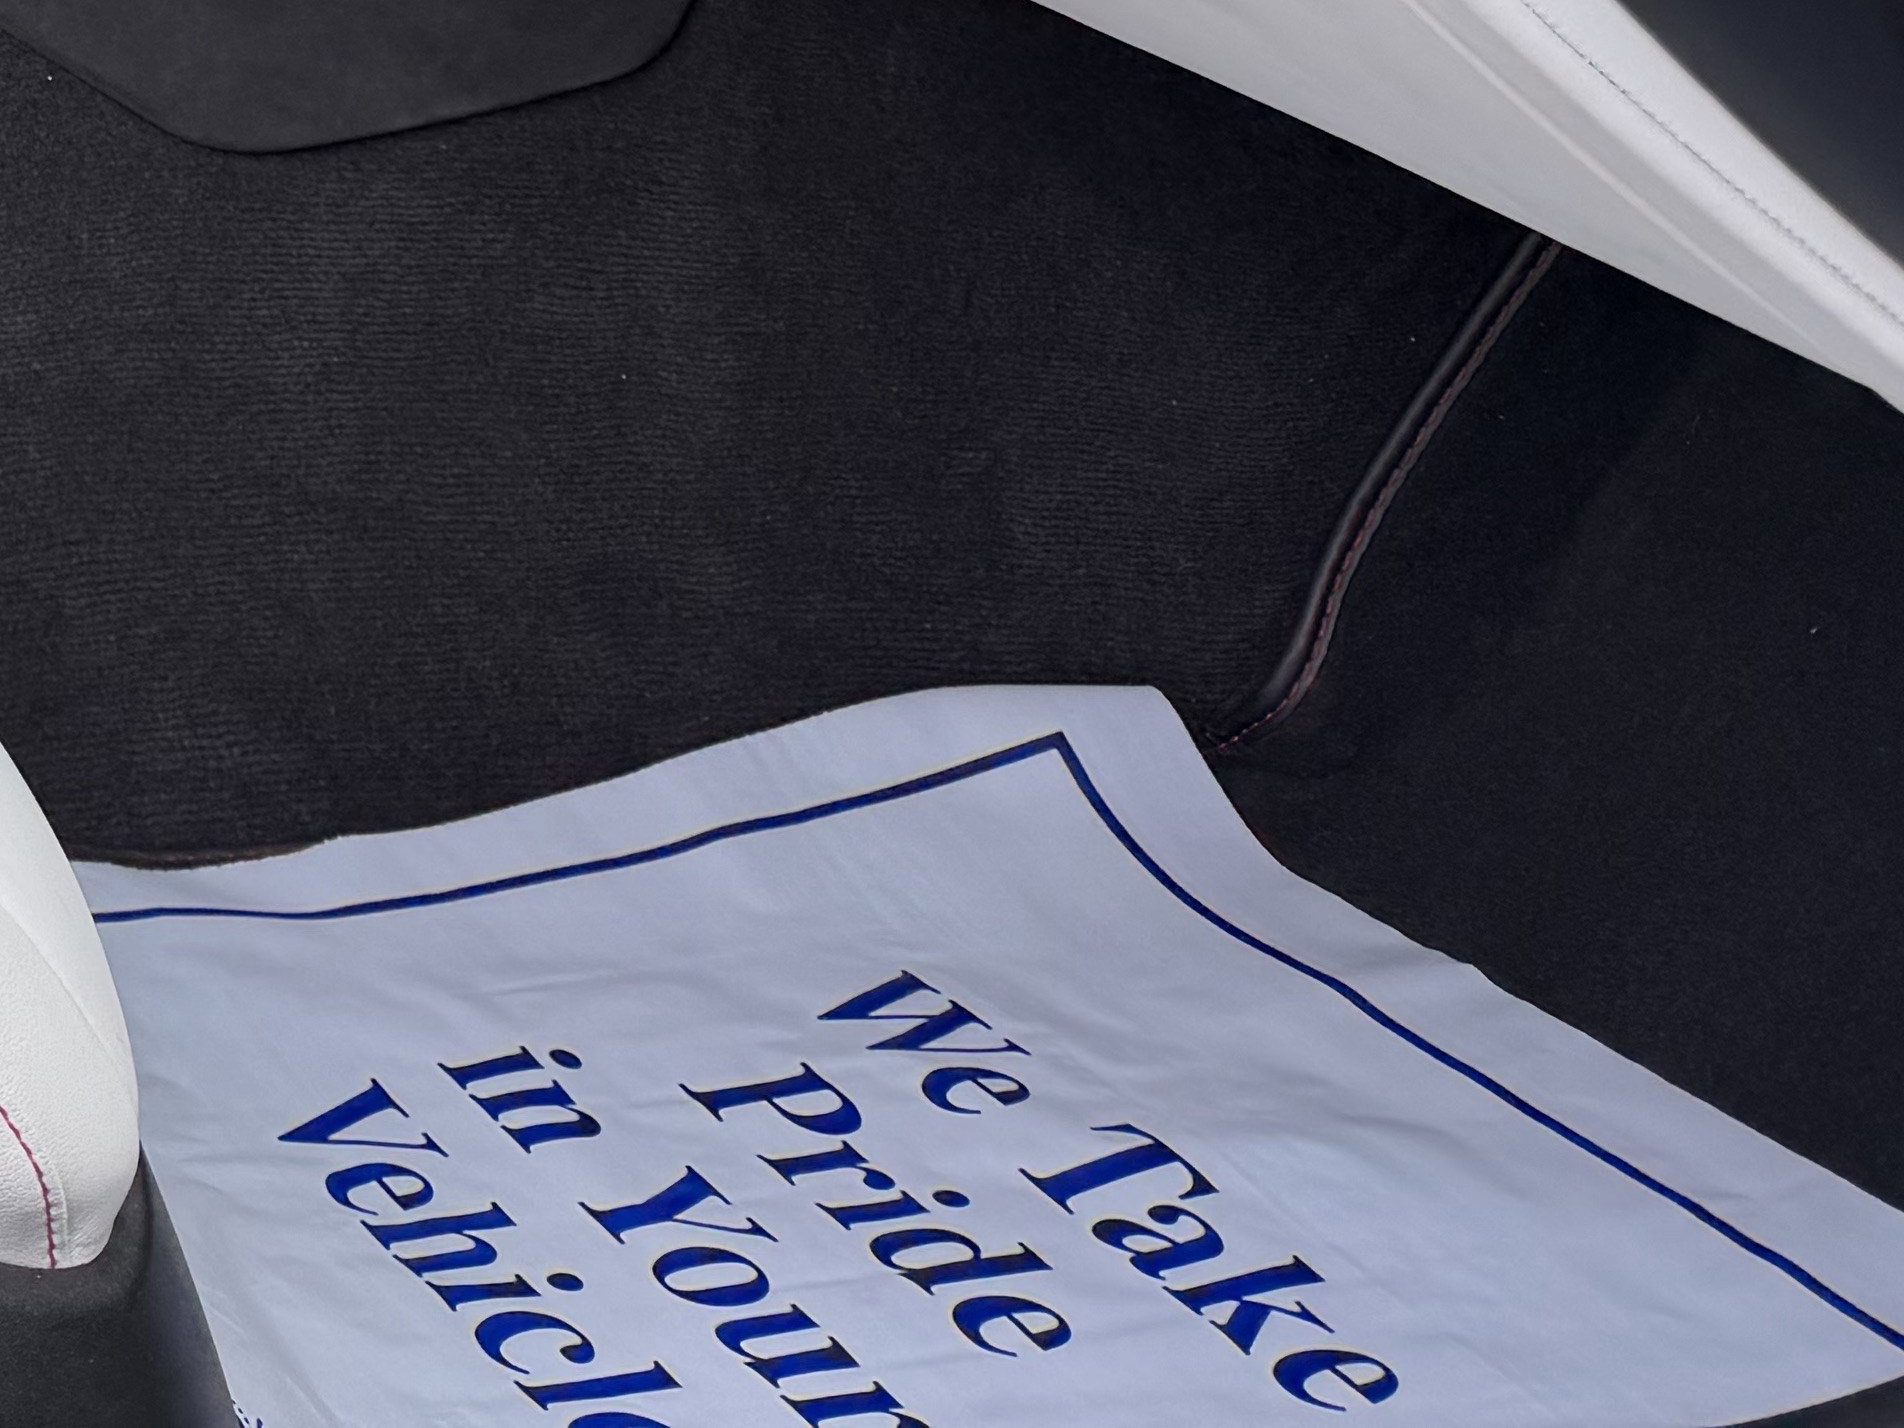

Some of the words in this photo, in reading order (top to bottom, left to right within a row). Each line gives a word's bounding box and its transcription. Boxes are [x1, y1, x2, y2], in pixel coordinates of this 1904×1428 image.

[436, 1044, 602, 1154] in
[577, 1164, 932, 1428] Your
[678, 1061, 1074, 1359] Pride
[817, 969, 1033, 1116] We
[1019, 1122, 1400, 1412] Take
